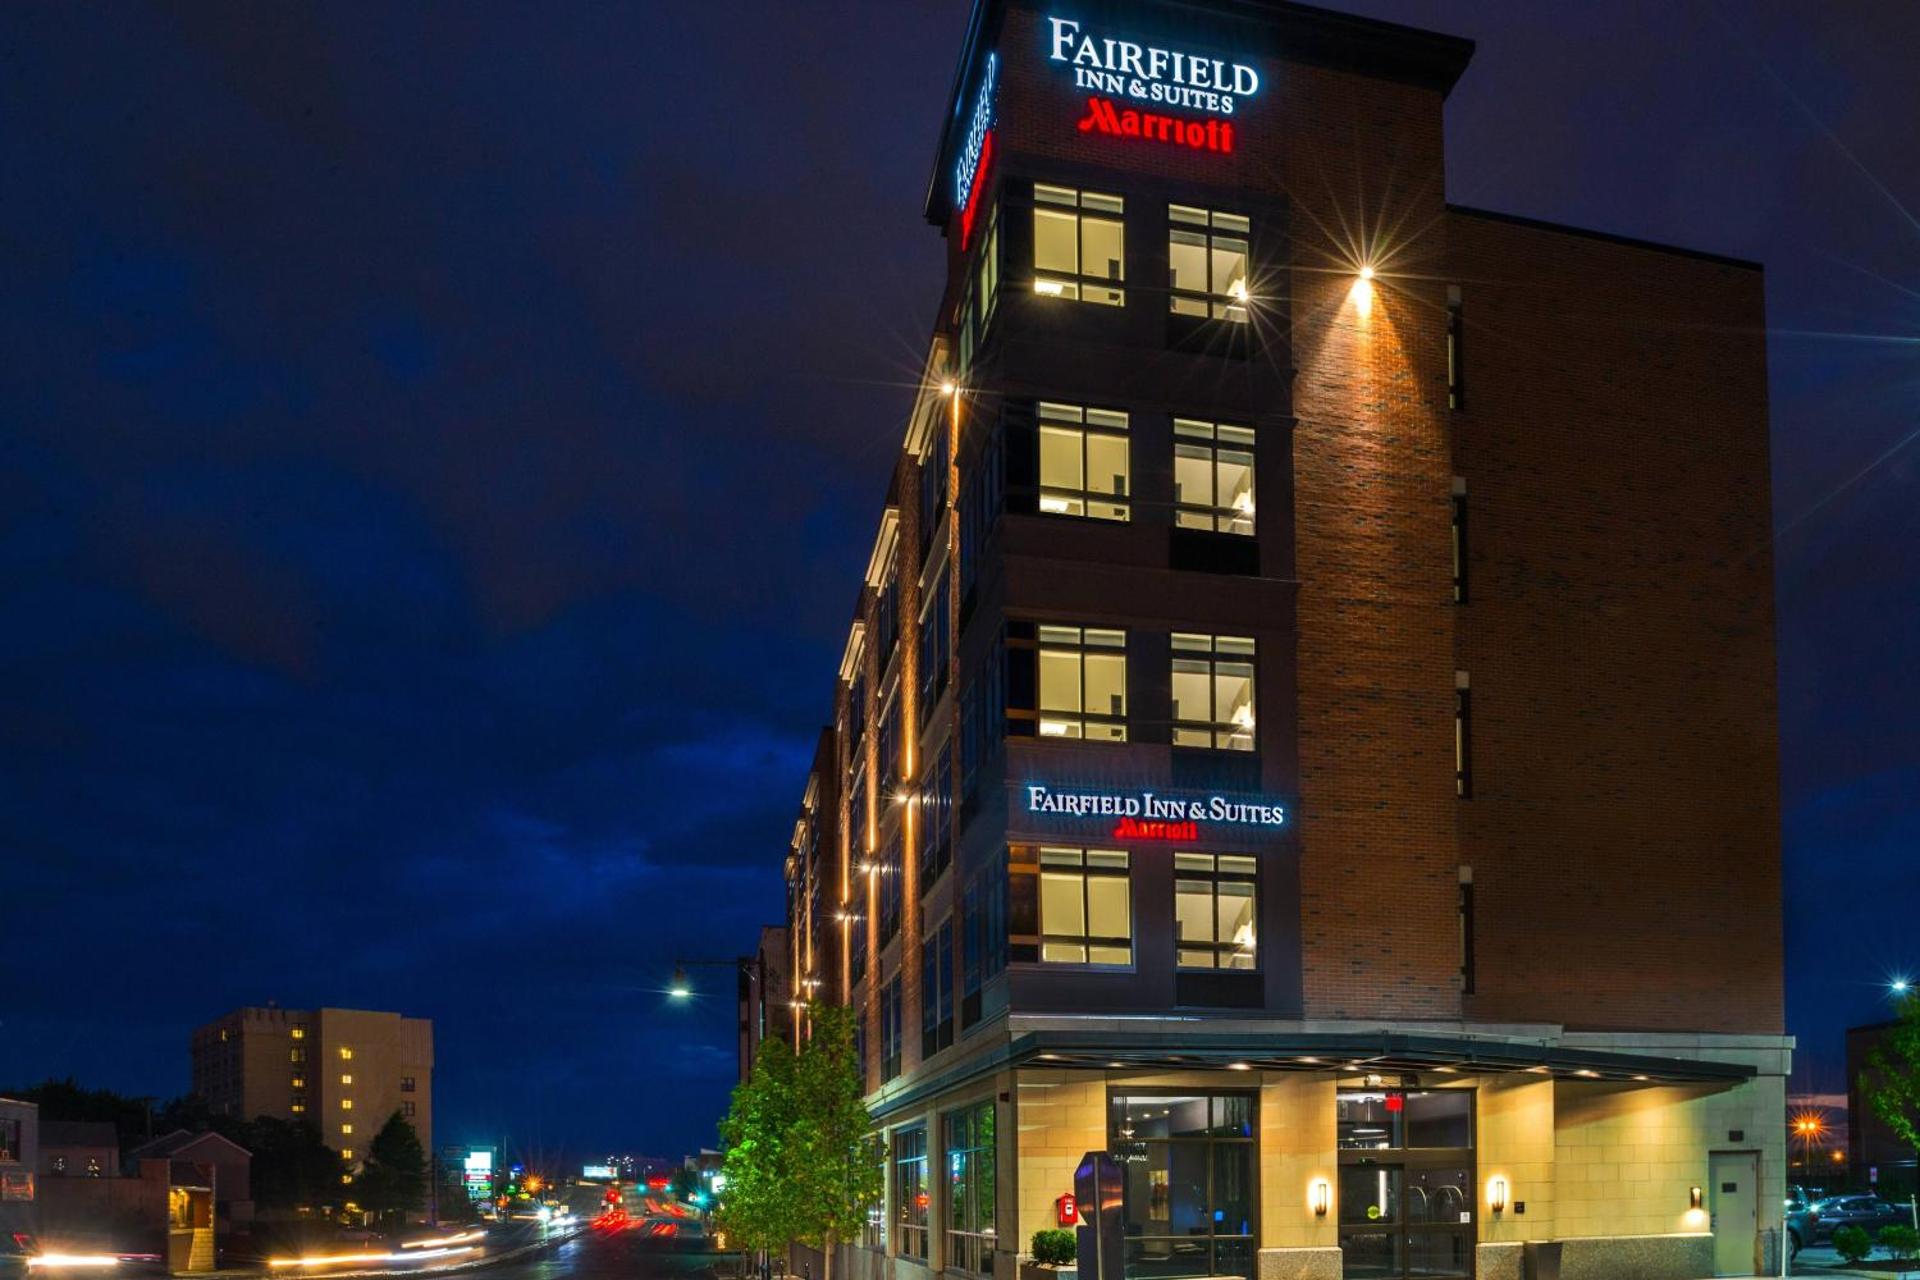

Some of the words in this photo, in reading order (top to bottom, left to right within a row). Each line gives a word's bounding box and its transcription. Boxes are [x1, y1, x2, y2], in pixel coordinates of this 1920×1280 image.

[1048, 17, 1259, 96] FAIRFIELD
[1075, 67, 1125, 95] INN
[1129, 79, 1148, 98] &
[1150, 82, 1234, 114] SUITES
[1078, 96, 1235, 154] Marriott
[1028, 786, 1140, 816] FAIRFIELD
[1143, 793, 1187, 819] INN
[1189, 801, 1207, 820] &
[1209, 796, 1284, 825] SUITES
[1114, 817, 1198, 841] Marriott
